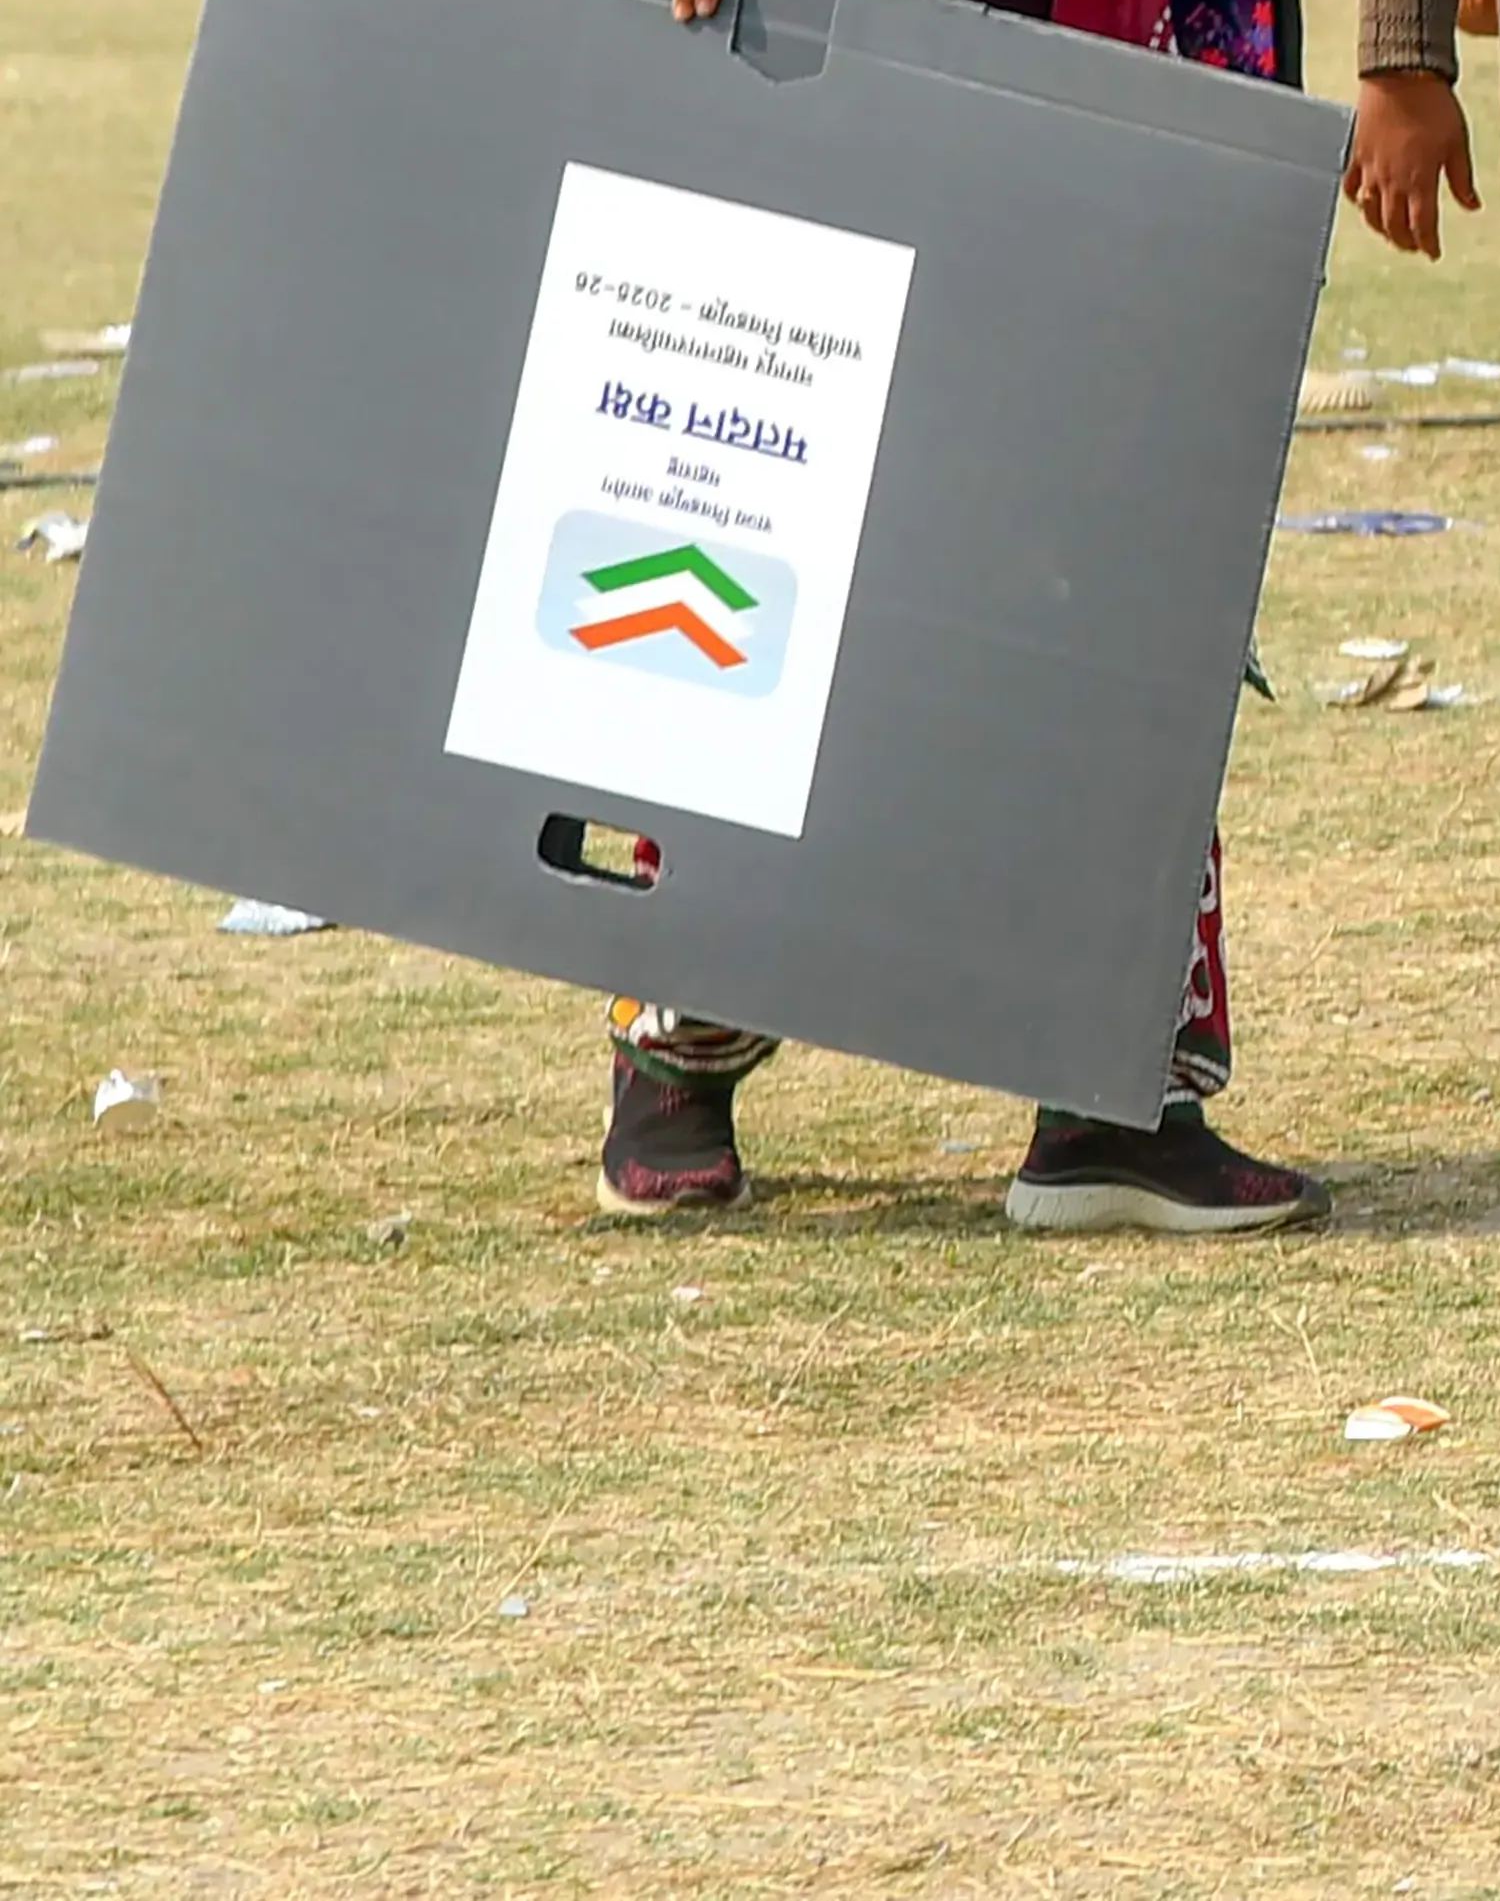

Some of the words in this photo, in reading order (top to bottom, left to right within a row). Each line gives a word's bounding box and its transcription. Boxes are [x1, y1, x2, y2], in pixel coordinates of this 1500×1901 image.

[574, 270, 673, 314] 2025-26
[608, 318, 749, 371] महानगरपालिका
[753, 348, 814, 386] नागपूर
[595, 380, 673, 432] कक्ष
[681, 400, 808, 466] मतदान
